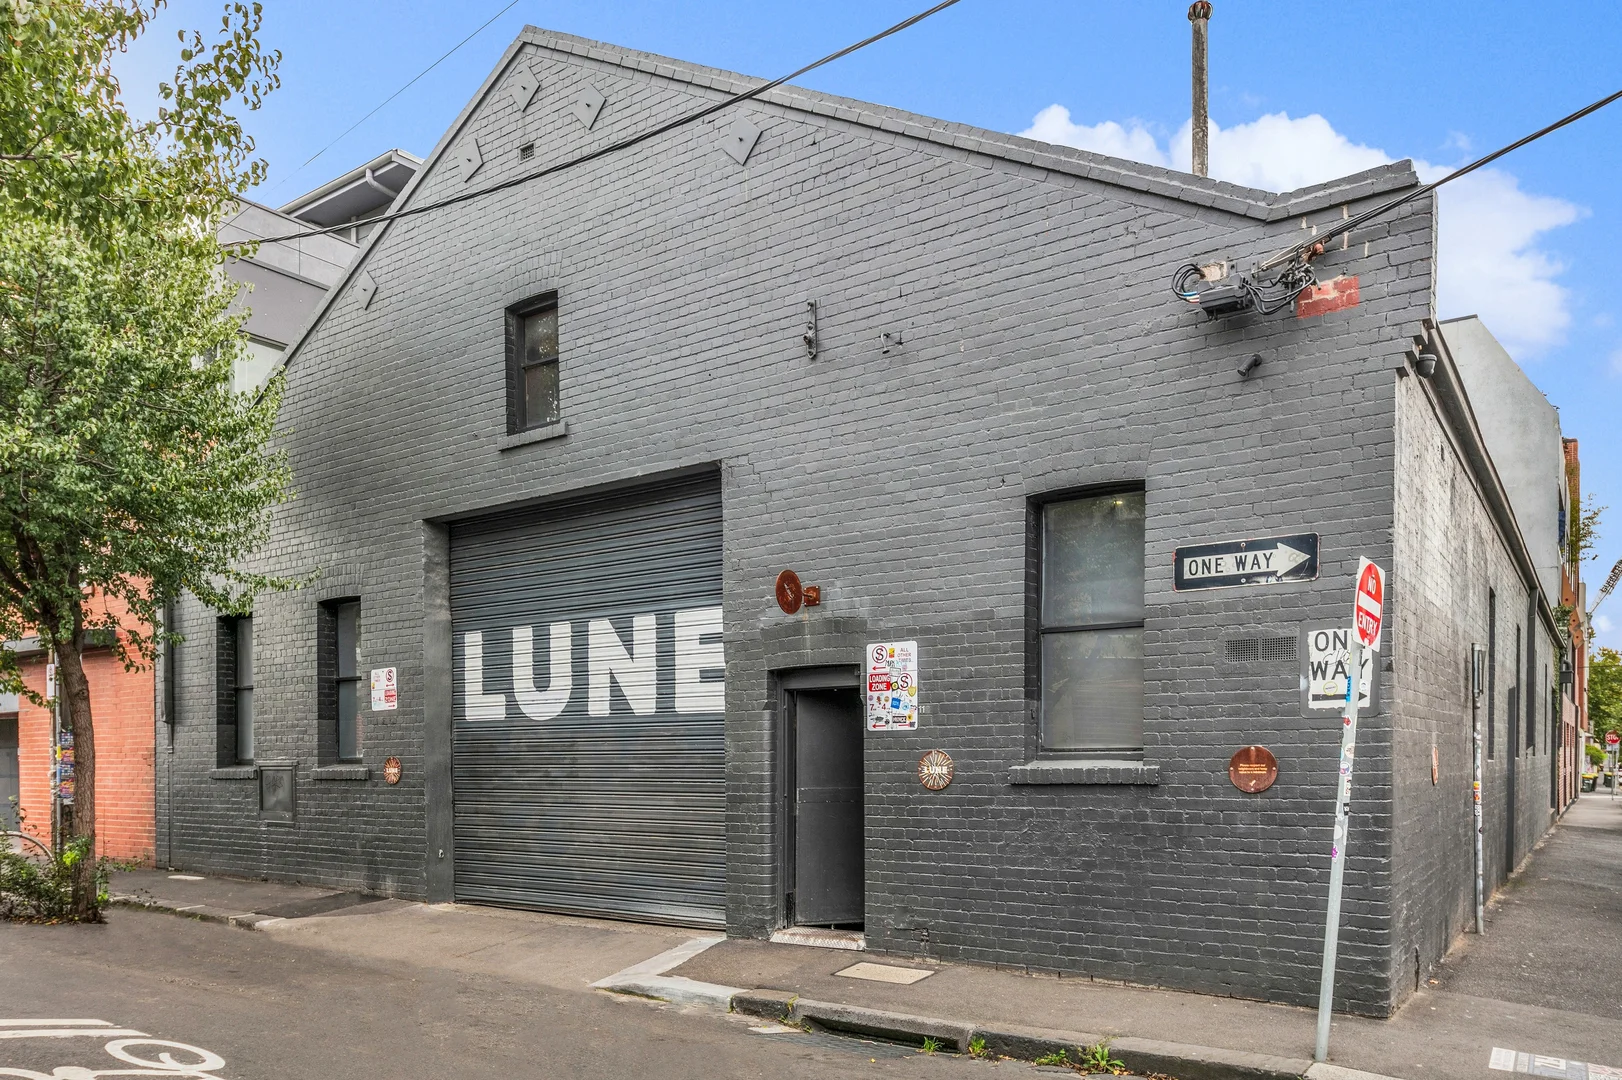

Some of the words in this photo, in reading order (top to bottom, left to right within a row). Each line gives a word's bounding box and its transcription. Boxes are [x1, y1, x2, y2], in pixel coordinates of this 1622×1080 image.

[1188, 557, 1224, 576] ONE
[1234, 552, 1274, 572] WAY
[1367, 575, 1377, 594] NO
[1359, 611, 1378, 635] ENTRY
[1314, 630, 1348, 652] ON
[465, 605, 726, 721] LUNE
[1310, 658, 1369, 681] WAY
[869, 675, 891, 683] LOADING
